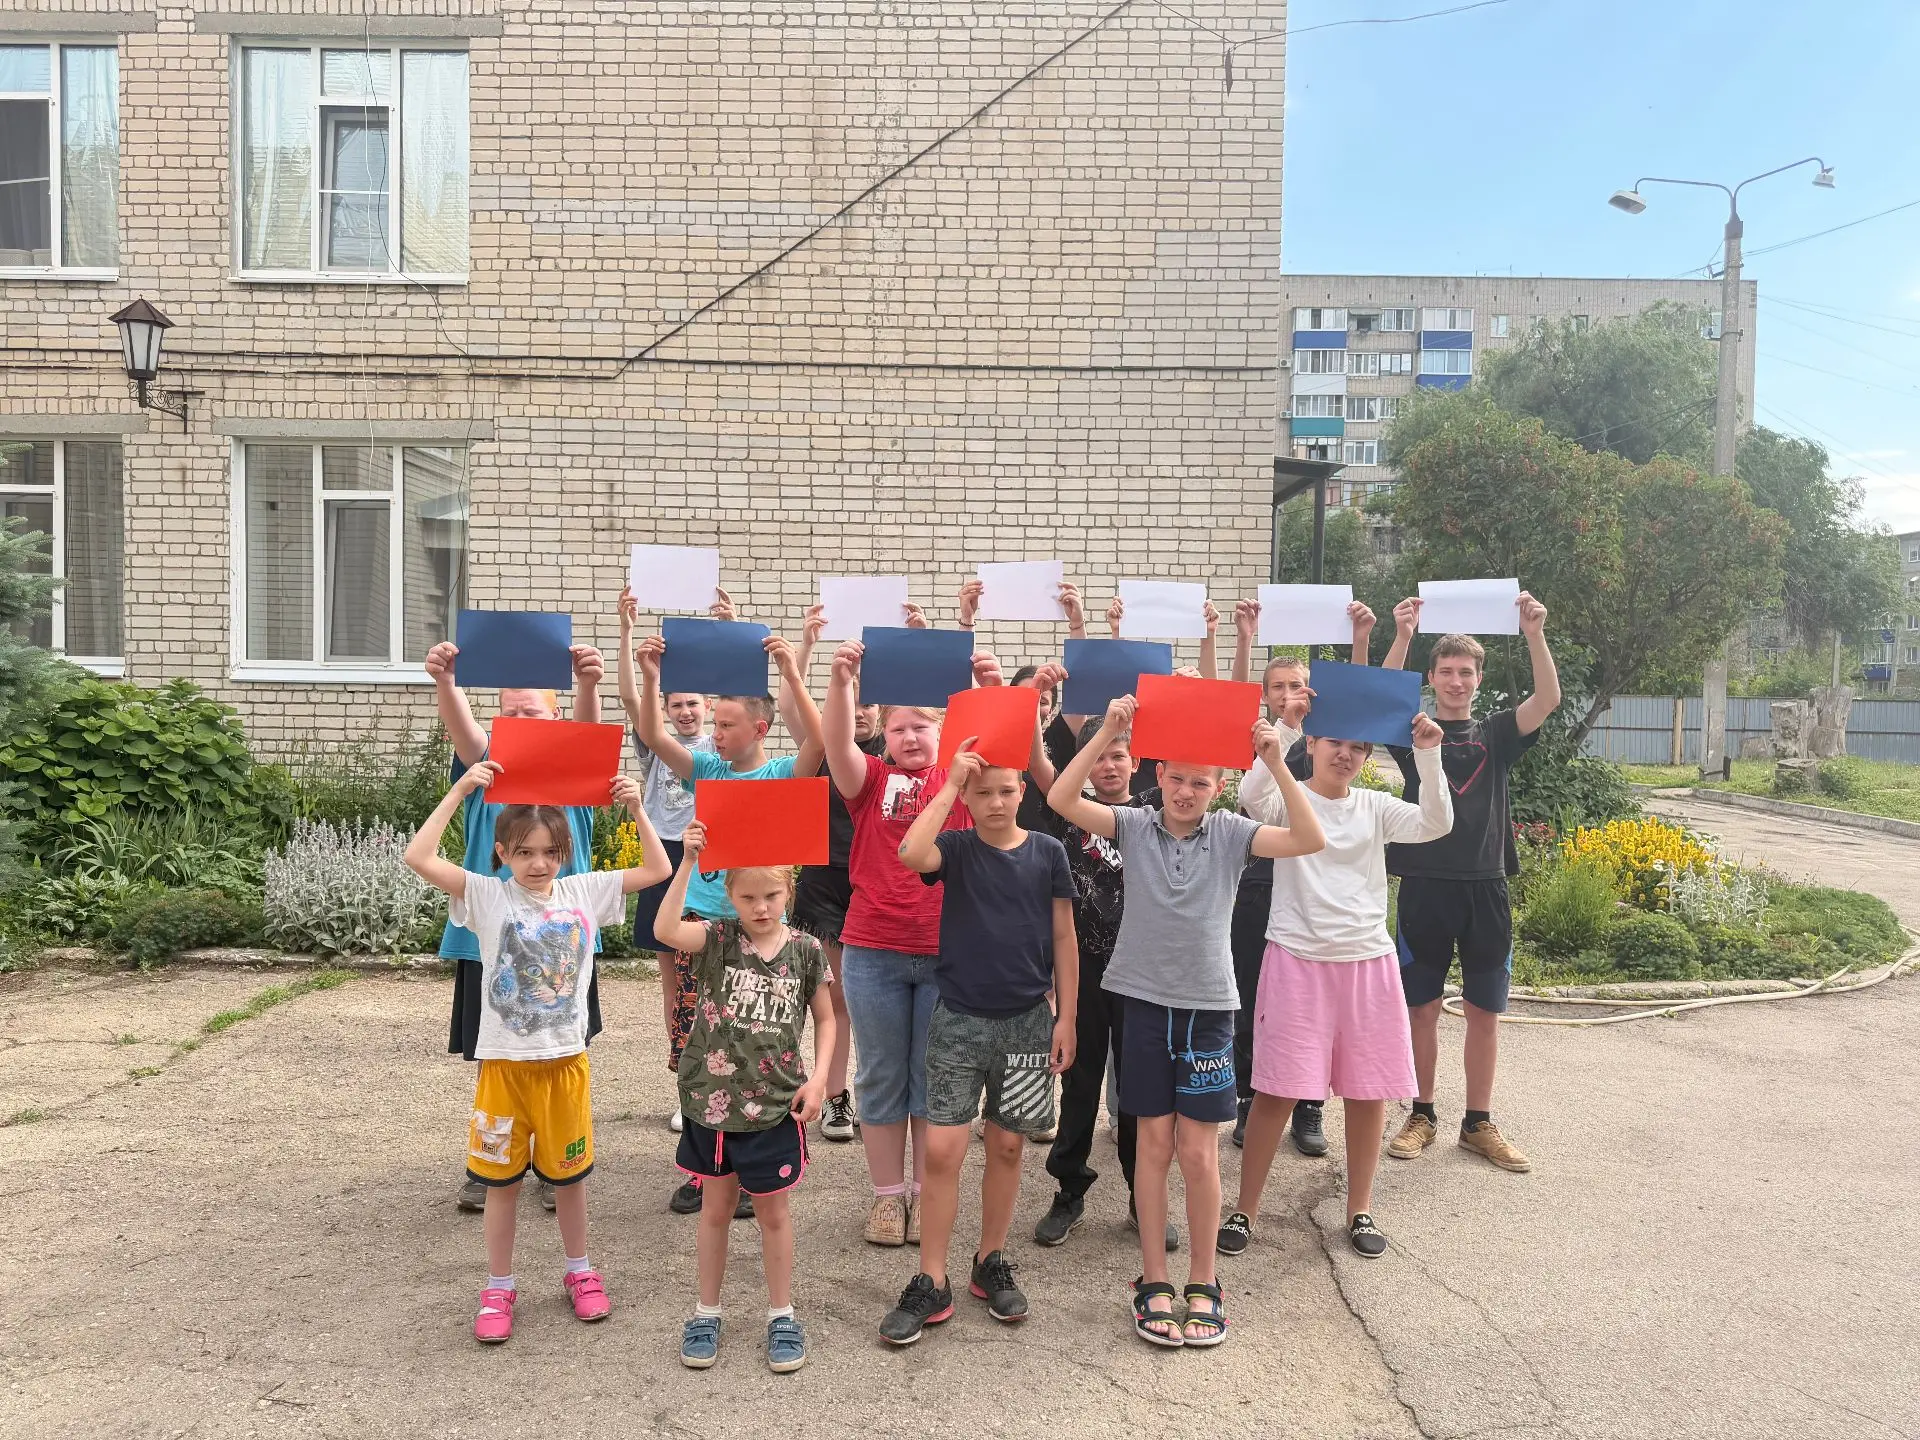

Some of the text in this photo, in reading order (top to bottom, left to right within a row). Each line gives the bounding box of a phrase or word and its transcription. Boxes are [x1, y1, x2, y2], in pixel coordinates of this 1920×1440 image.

[721, 966, 801, 1006] FOREVER
[728, 991, 793, 1024] STATE
[730, 1018, 751, 1029] New
[1006, 1053, 1051, 1068] WHIT
[1193, 1054, 1230, 1072] WAVE
[565, 1135, 586, 1161] 95
